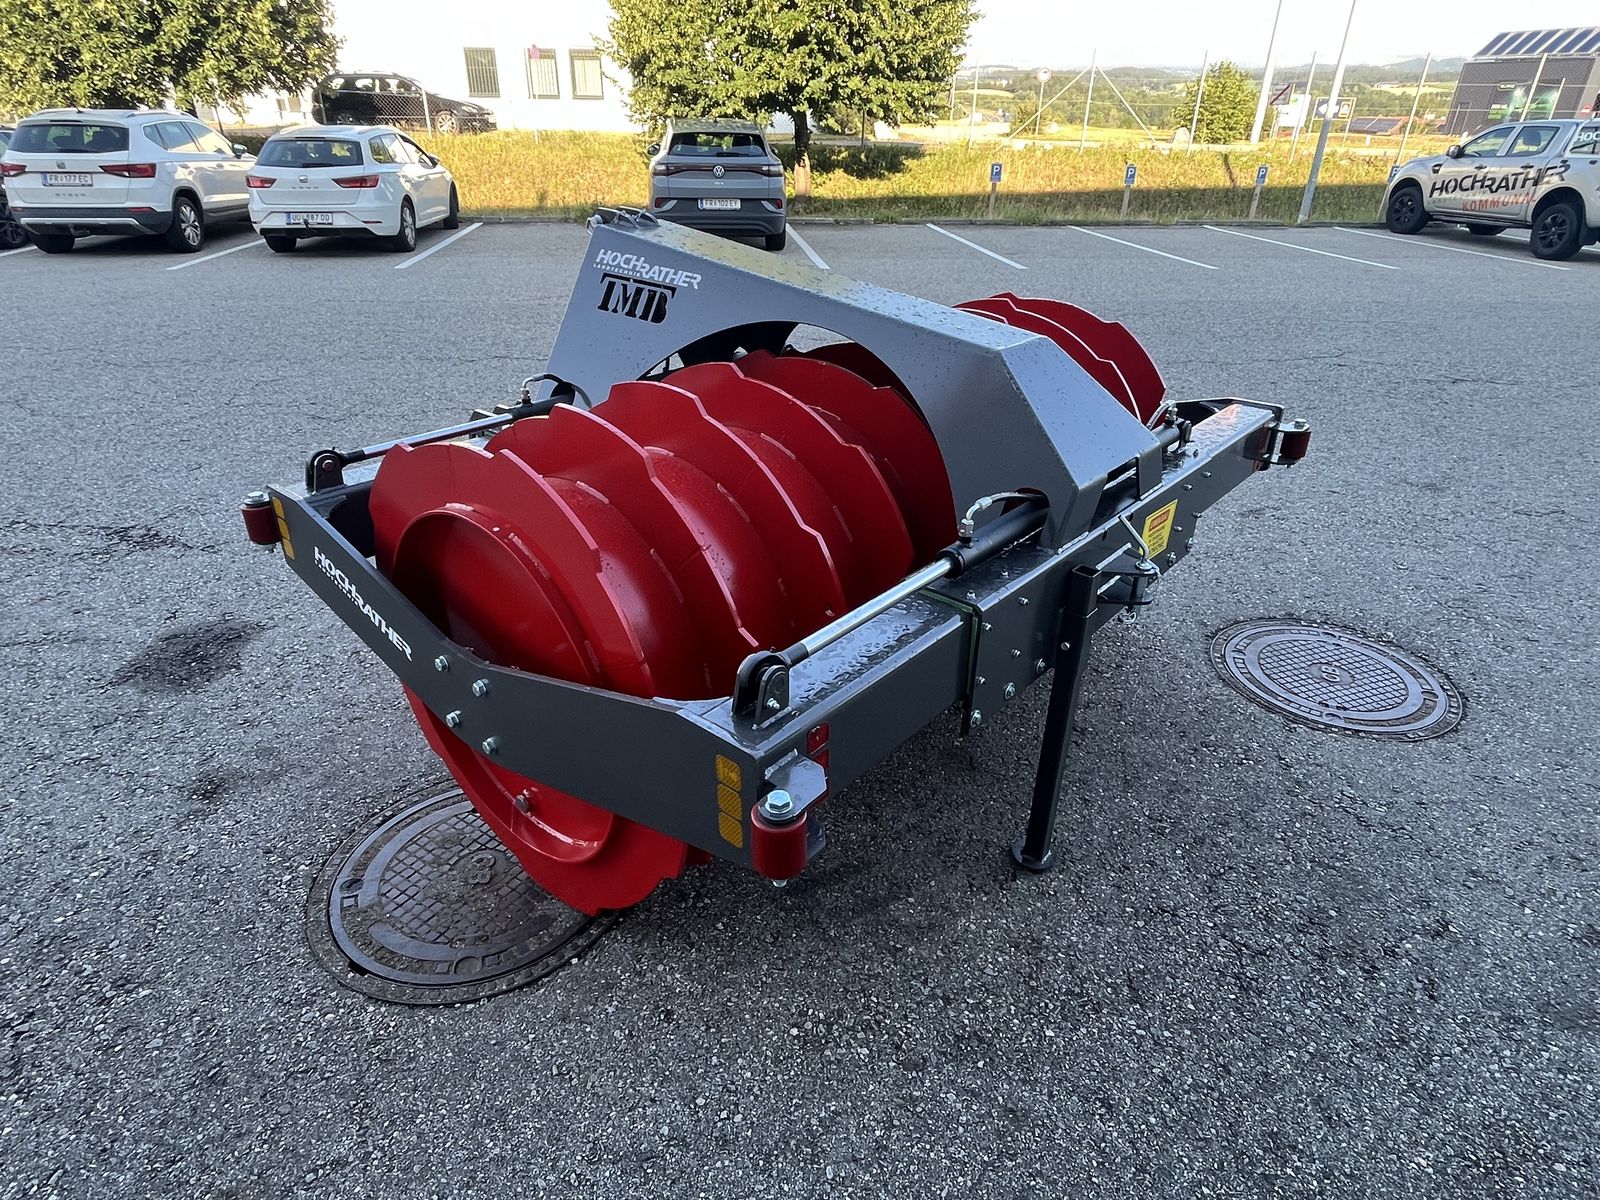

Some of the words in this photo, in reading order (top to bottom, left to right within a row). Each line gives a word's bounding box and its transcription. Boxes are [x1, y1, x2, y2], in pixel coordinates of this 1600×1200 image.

[993, 165, 1000, 175] P
[1128, 168, 1135, 178] P
[1258, 168, 1266, 178] P
[1429, 164, 1570, 198] HOCHRATHER
[595, 249, 702, 290] HOCHRATHER
[597, 272, 677, 324] TMB
[314, 546, 412, 662] HOCHRATHER
